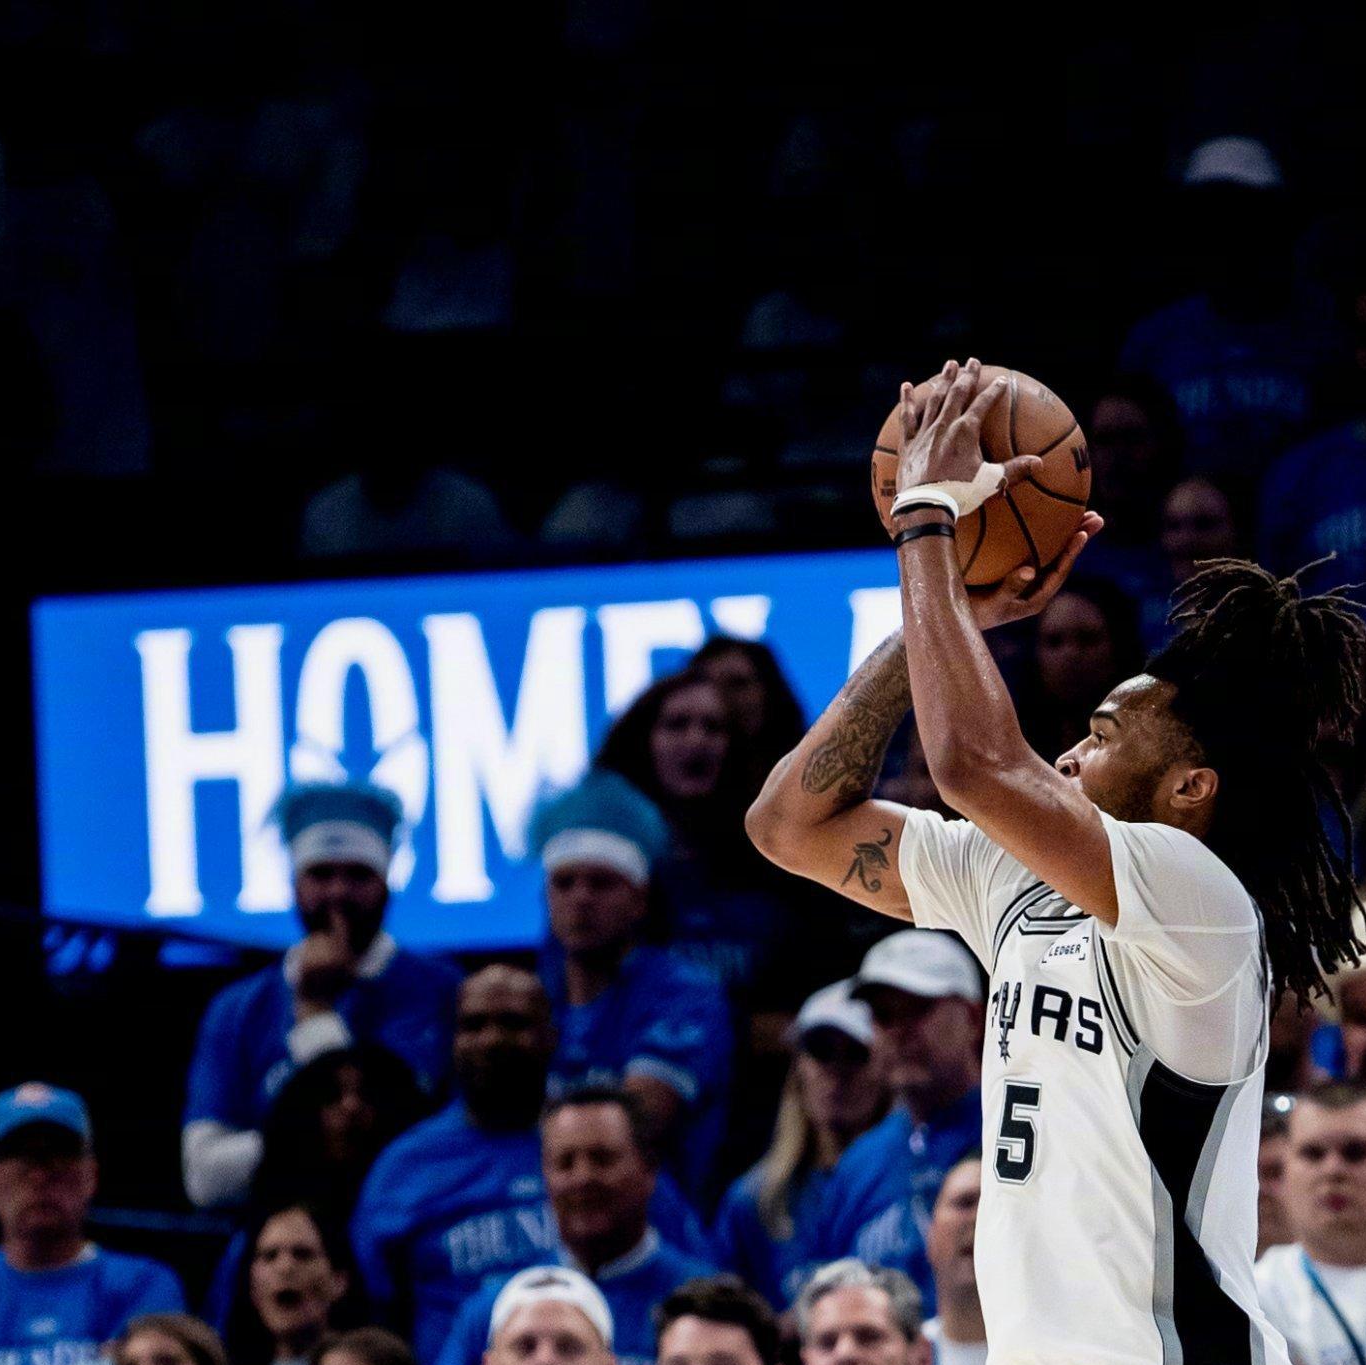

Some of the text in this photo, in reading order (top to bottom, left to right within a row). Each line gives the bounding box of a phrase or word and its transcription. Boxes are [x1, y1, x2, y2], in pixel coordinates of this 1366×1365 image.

[133, 585, 903, 918] HOM
[1048, 943, 1082, 958] LEDGER
[993, 1079, 1043, 1186] 5
